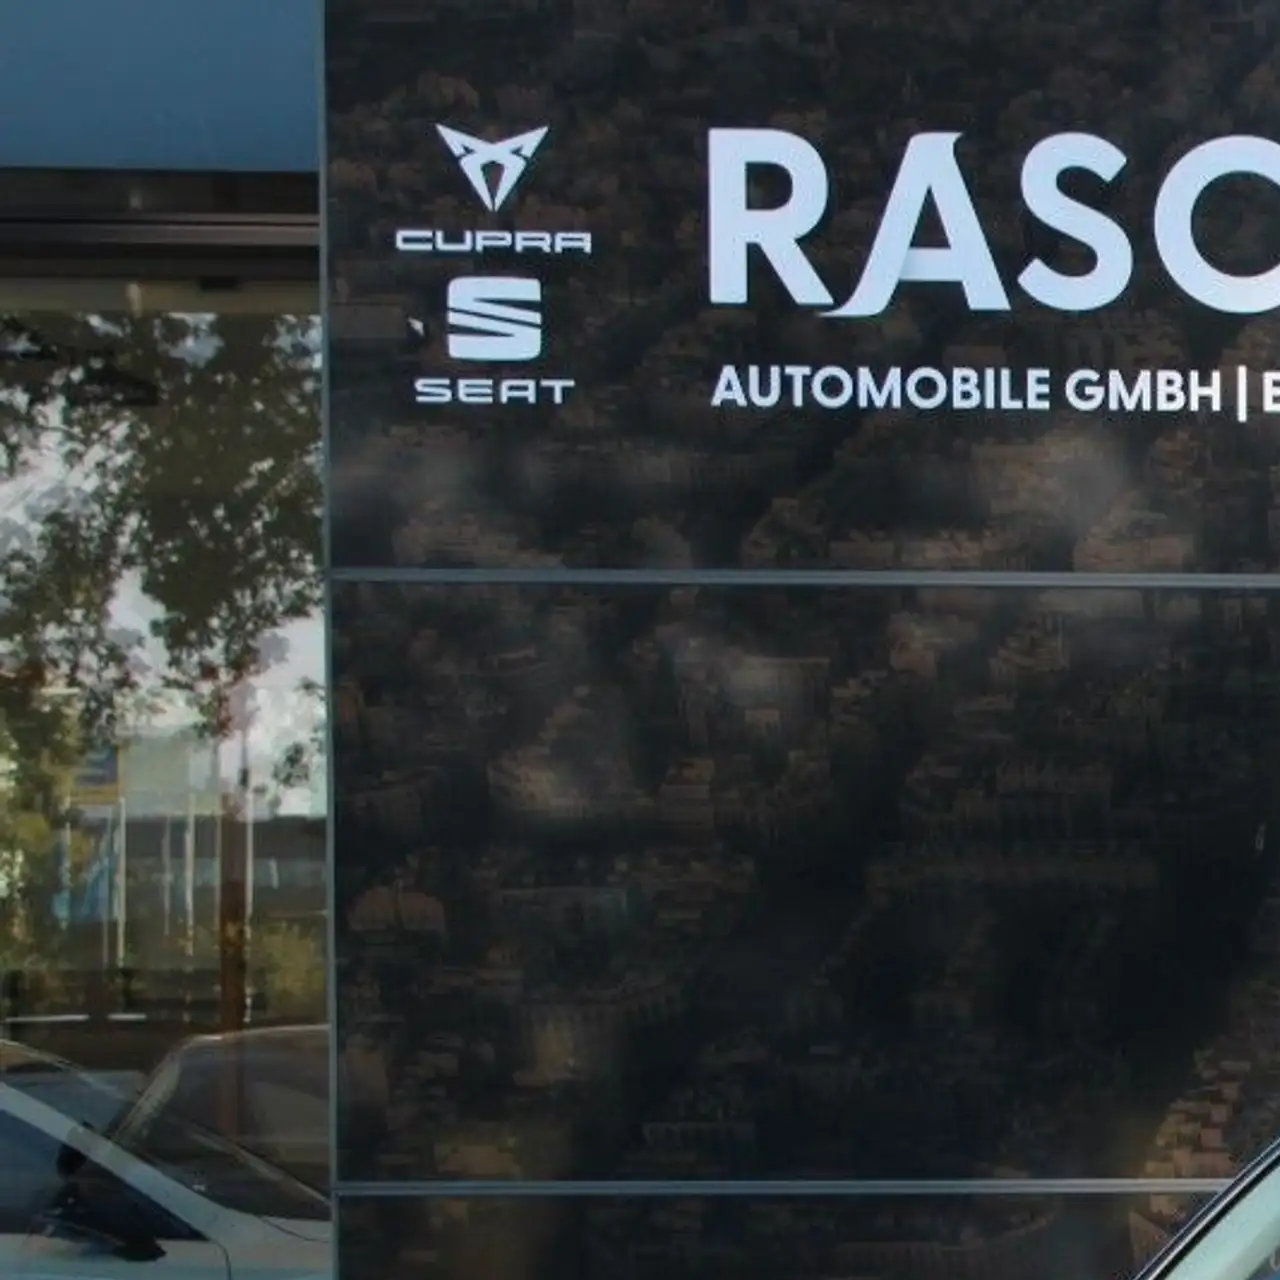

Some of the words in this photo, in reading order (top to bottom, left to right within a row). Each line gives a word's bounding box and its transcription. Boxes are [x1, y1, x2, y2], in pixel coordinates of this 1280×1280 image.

[395, 229, 592, 253] CUPRA
[414, 377, 575, 404] SEAT
[710, 364, 1051, 411] AUTOMOBILE
[1064, 367, 1223, 413] GMBH
